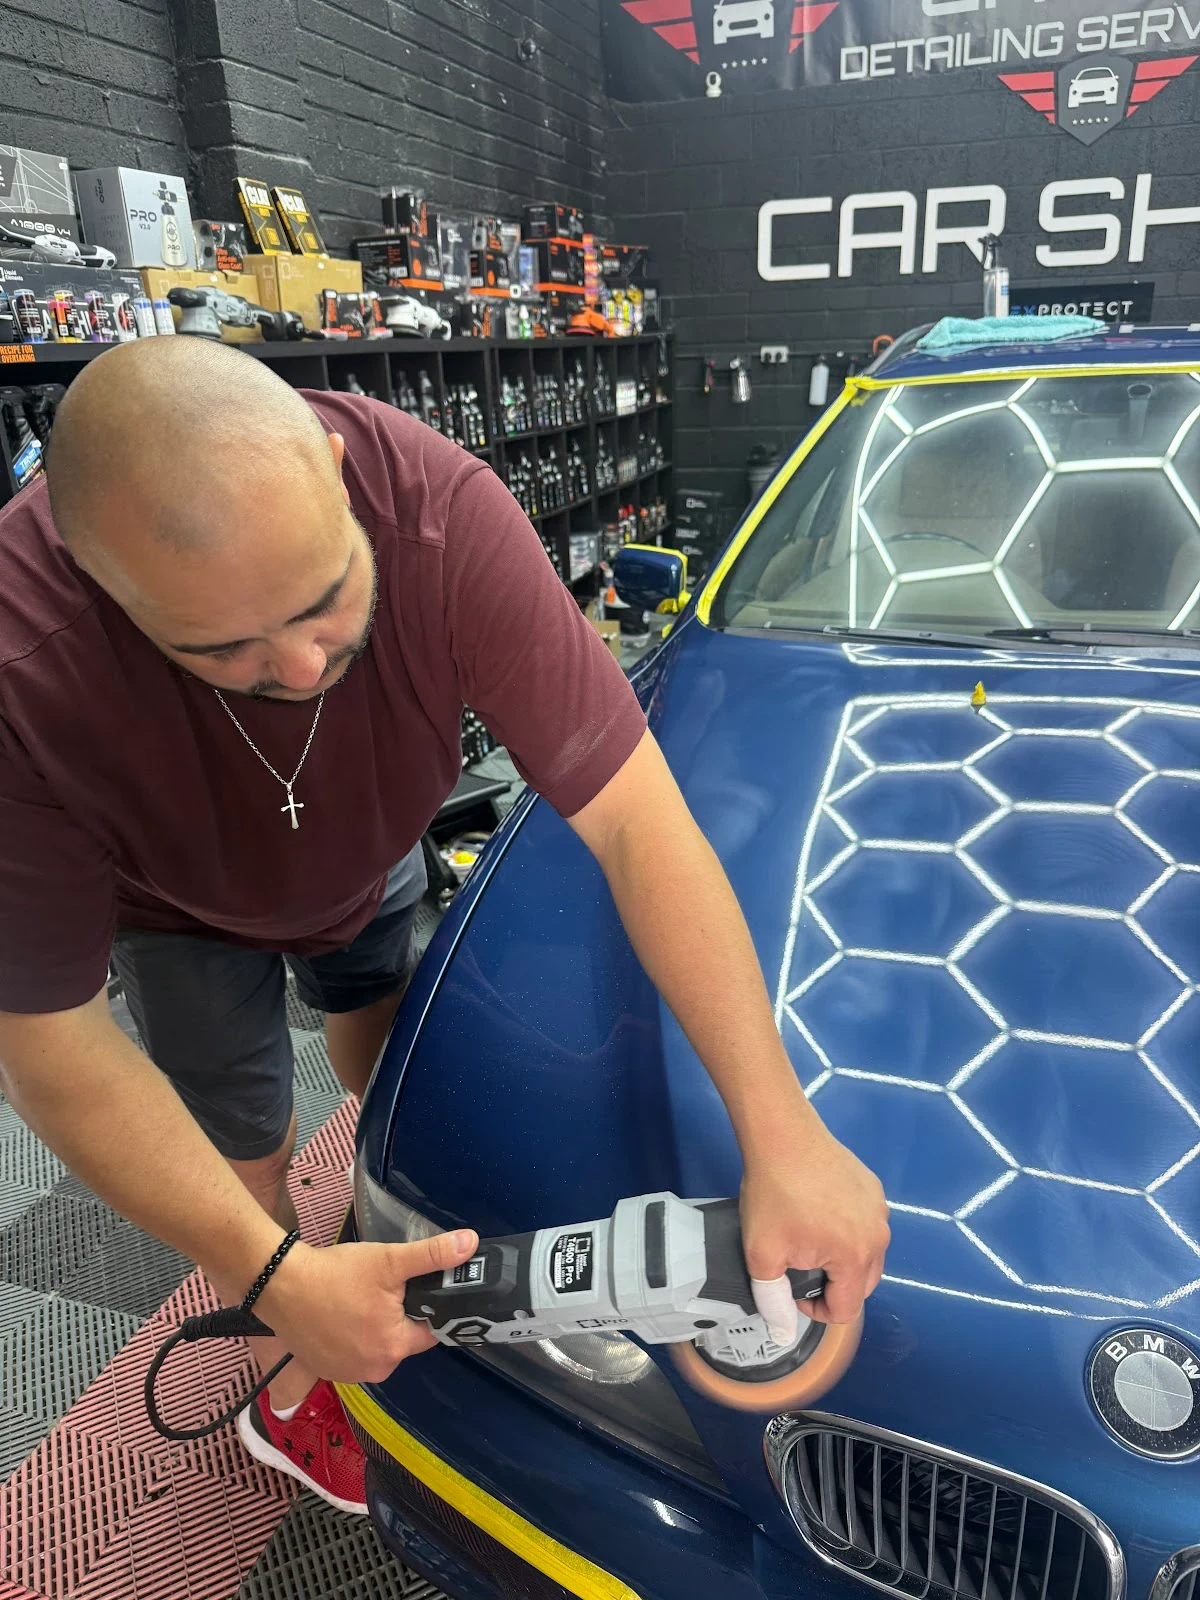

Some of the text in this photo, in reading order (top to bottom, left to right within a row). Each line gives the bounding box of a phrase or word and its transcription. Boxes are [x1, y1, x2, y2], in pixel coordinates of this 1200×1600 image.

[840, 21, 1063, 81] DETAILING
[129, 208, 158, 223] PRO
[757, 184, 1006, 281] CAR
[565, 1237, 577, 1285] T4500 Pro
[1104, 1333, 1200, 1381] BMW
